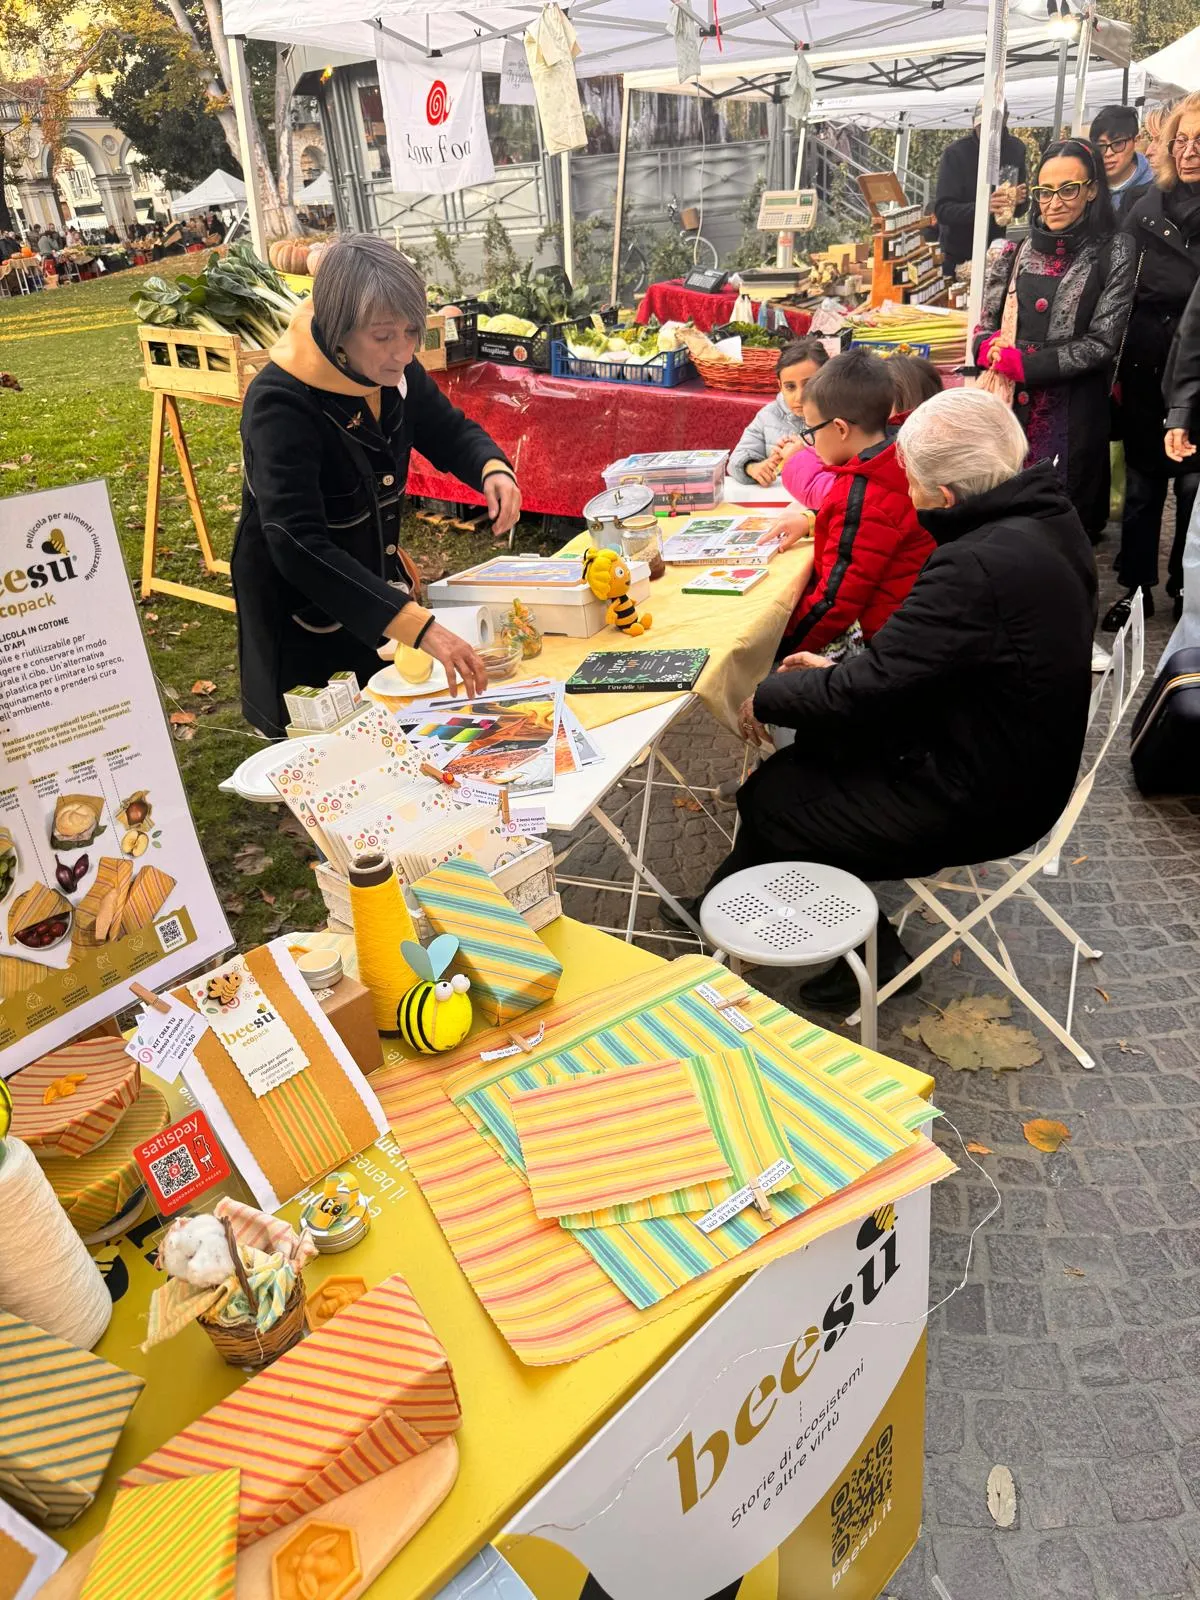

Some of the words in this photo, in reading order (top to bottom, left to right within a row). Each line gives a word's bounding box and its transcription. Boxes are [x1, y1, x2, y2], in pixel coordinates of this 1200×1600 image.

[26, 518, 47, 549] pellicola
[47, 513, 61, 522] per
[63, 512, 95, 533] alimenti
[84, 533, 102, 581] riutilizzabile
[28, 626, 37, 635] IN
[38, 617, 70, 632] COTONE
[4, 639, 26, 652] D'API
[22, 637, 71, 659] riutilizzabile
[72, 634, 86, 645] per
[30, 648, 75, 667] conservare
[76, 645, 84, 653] in
[86, 638, 107, 650] modo
[22, 672, 27, 681] il
[29, 667, 48, 679] cibo.
[49, 651, 105, 672] Un'alternativa
[61, 675, 98, 692] prendersi
[100, 668, 117, 678] cura
[5, 682, 38, 699] plastica
[39, 676, 53, 687] per
[55, 668, 86, 681] limitare
[87, 664, 95, 672] lo
[152, 1038, 161, 1049] KIT
[158, 1025, 171, 1039] CREA
[168, 1017, 176, 1026] TU
[177, 1047, 188, 1060] euro
[185, 1033, 197, 1048] 6,50
[267, 1058, 276, 1067] per
[142, 1117, 199, 1159] satispay
[761, 1164, 791, 1188] PICCOLO
[718, 1204, 740, 1221] 18x18
[731, 1470, 775, 1529] Storie
[779, 1446, 792, 1470] di
[795, 1358, 865, 1450] ecosistemi
[763, 1497, 771, 1511] e
[775, 1453, 807, 1497] altre
[810, 1411, 840, 1452] virtù
[831, 1497, 893, 1590] beesu.it
